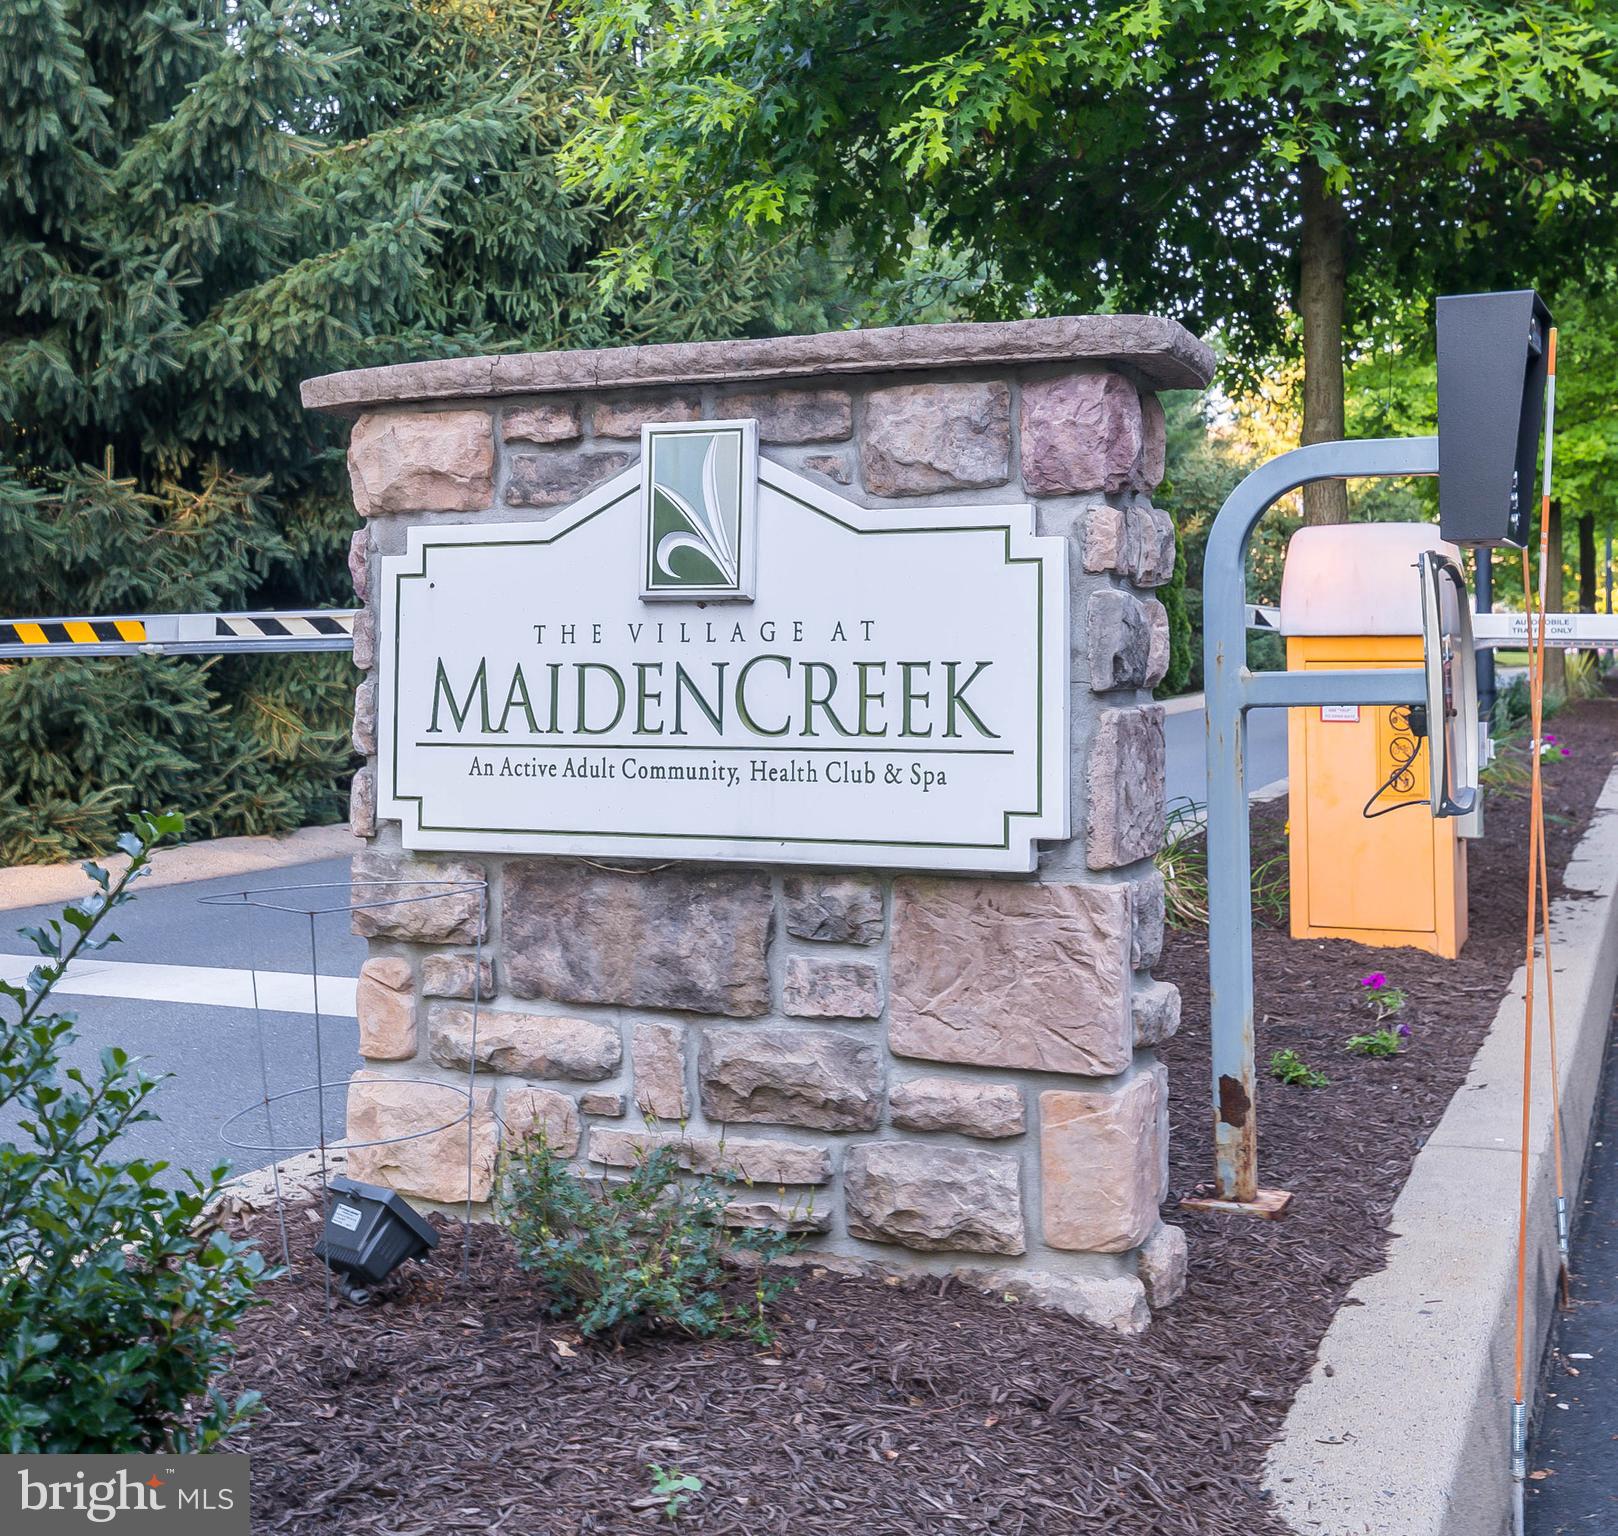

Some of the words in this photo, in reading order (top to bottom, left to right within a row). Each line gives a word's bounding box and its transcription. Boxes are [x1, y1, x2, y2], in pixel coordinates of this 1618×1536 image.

[533, 624, 602, 645] THE
[627, 621, 803, 644] VILLAGE
[830, 620, 875, 642] AT
[425, 653, 1002, 739] MAIDENCREEK
[468, 755, 498, 777] An
[498, 756, 557, 778] Active
[561, 756, 616, 779] Adult
[621, 757, 740, 788] Community,
[749, 759, 819, 783] Health
[825, 759, 880, 784] Club
[883, 763, 903, 785] &
[909, 762, 948, 793] Spa
